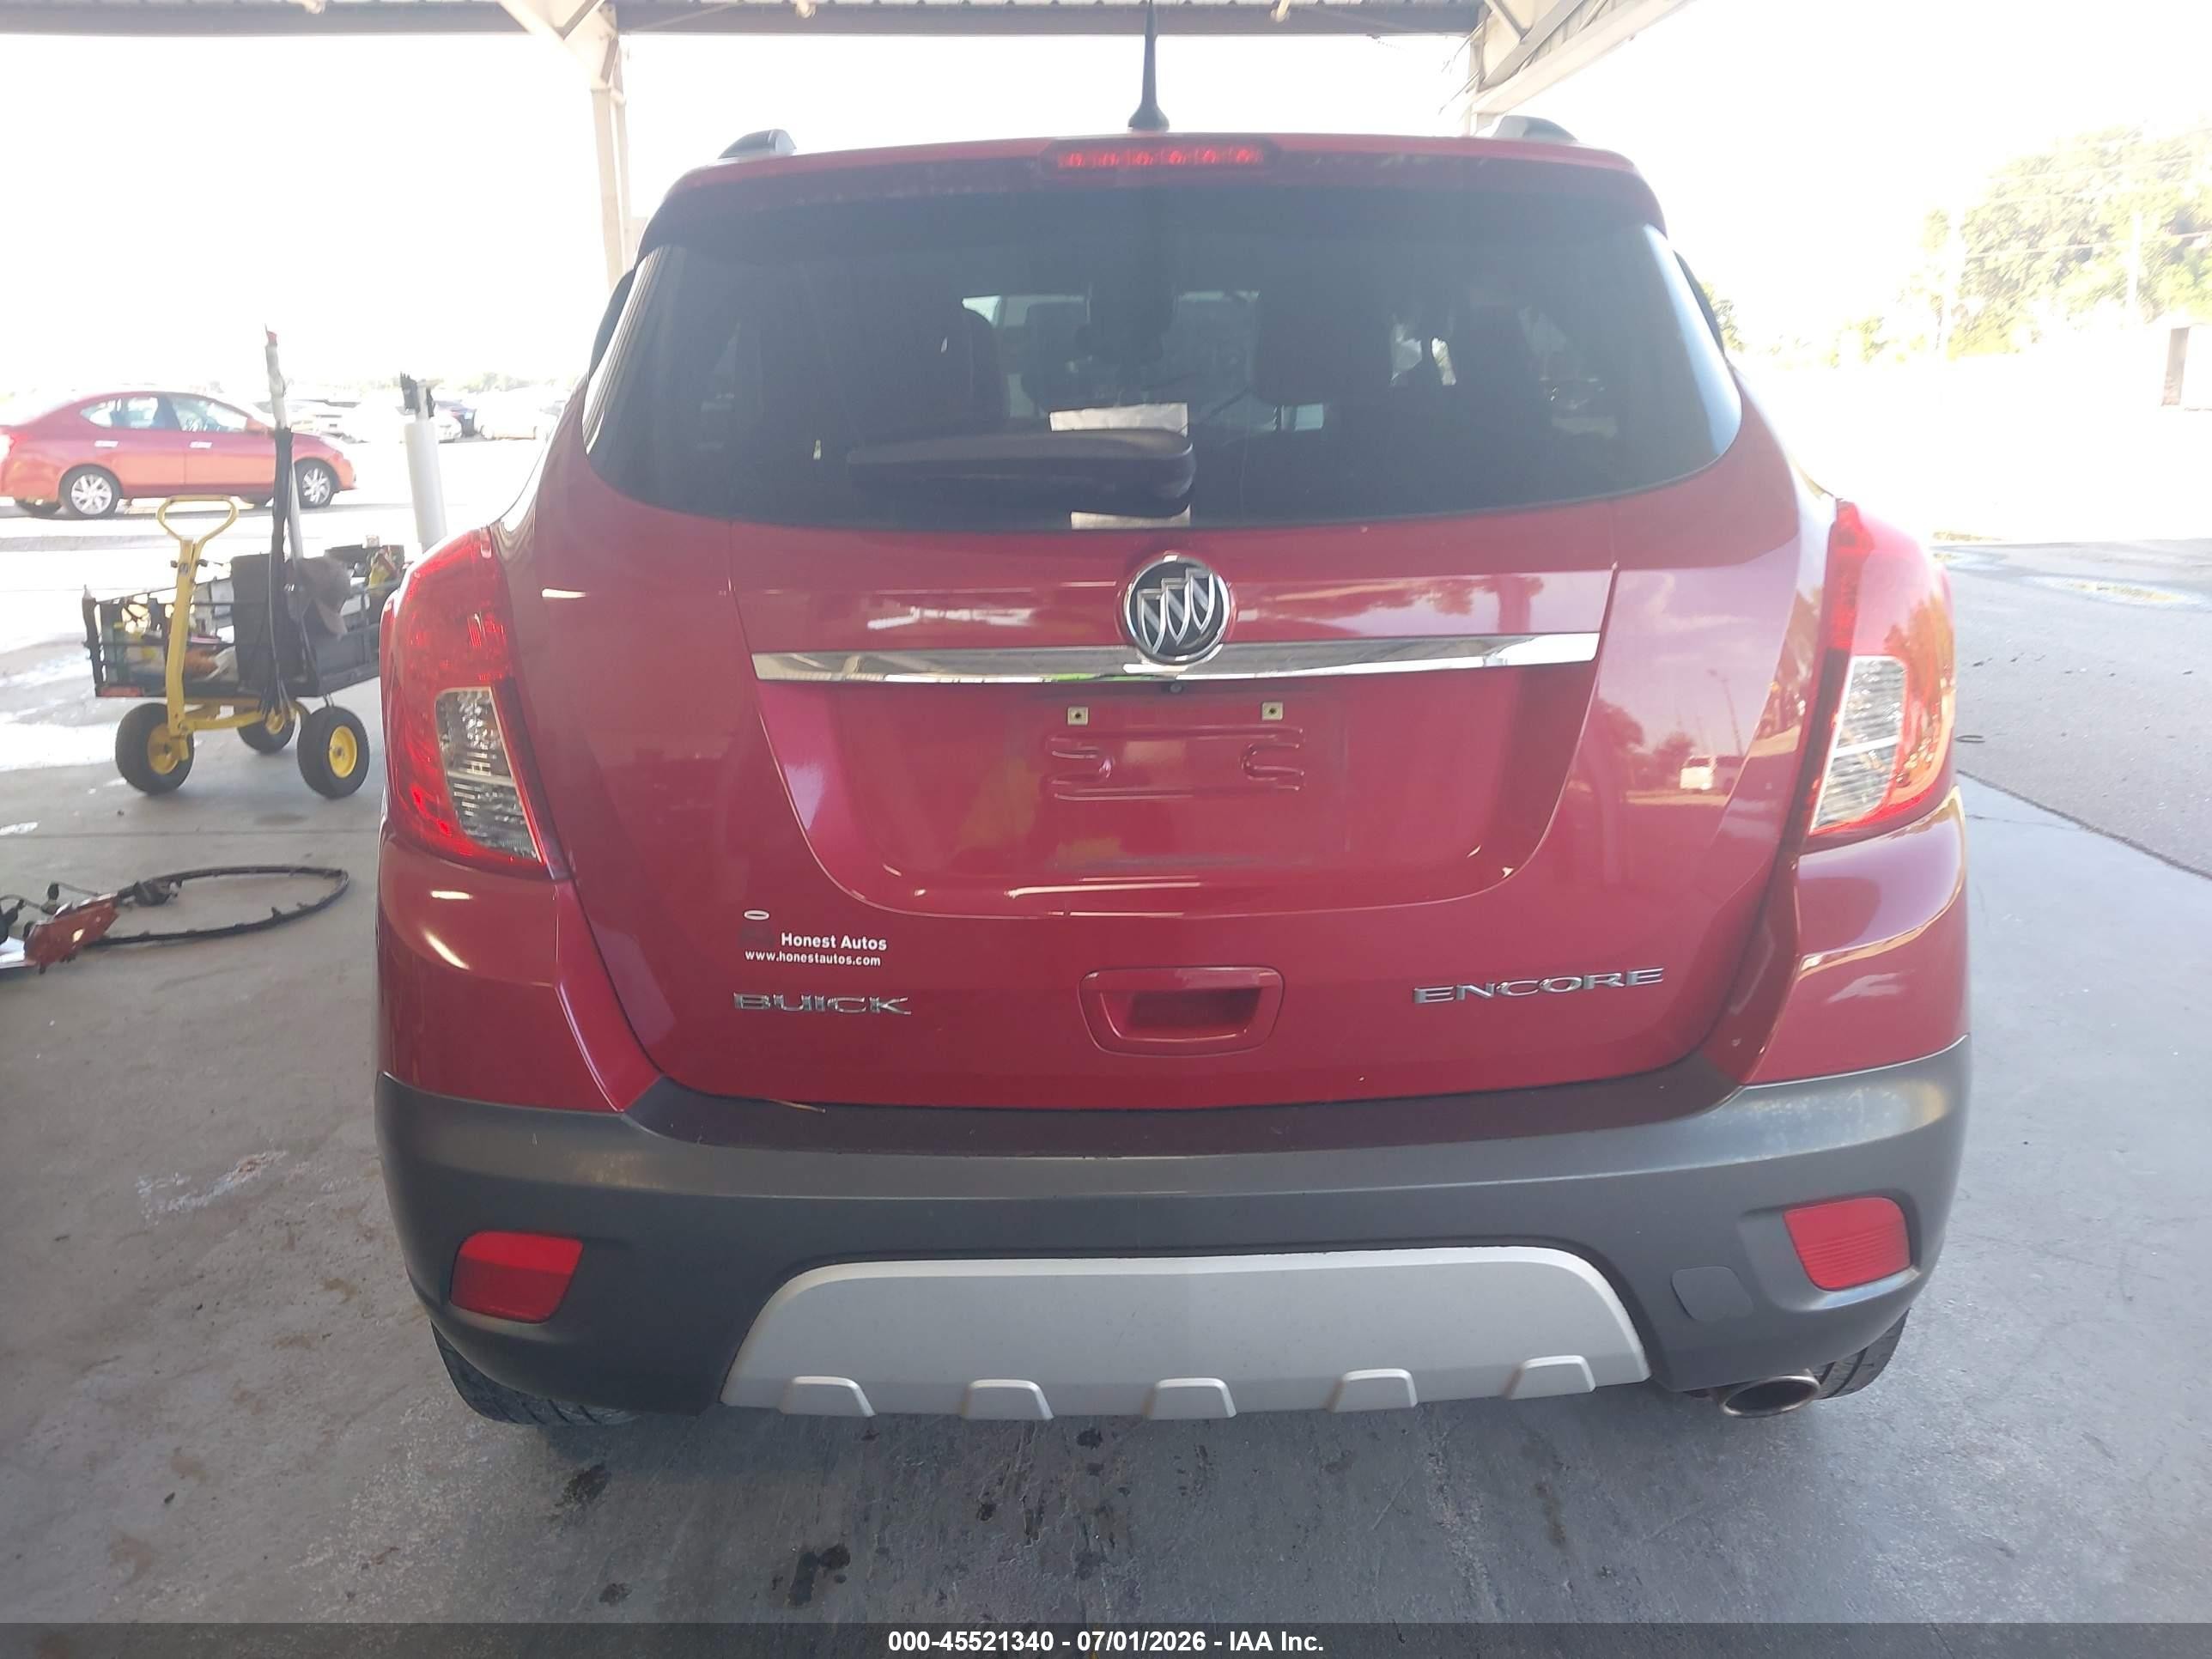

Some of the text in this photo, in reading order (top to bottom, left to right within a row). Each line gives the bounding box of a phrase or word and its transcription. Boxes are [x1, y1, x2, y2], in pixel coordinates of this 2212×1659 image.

[781, 933, 888, 951] Honest Autos
[744, 950, 881, 967] www.honestautos.com
[1413, 967, 1665, 1005] ENCORE
[733, 991, 912, 1016] BUICK
